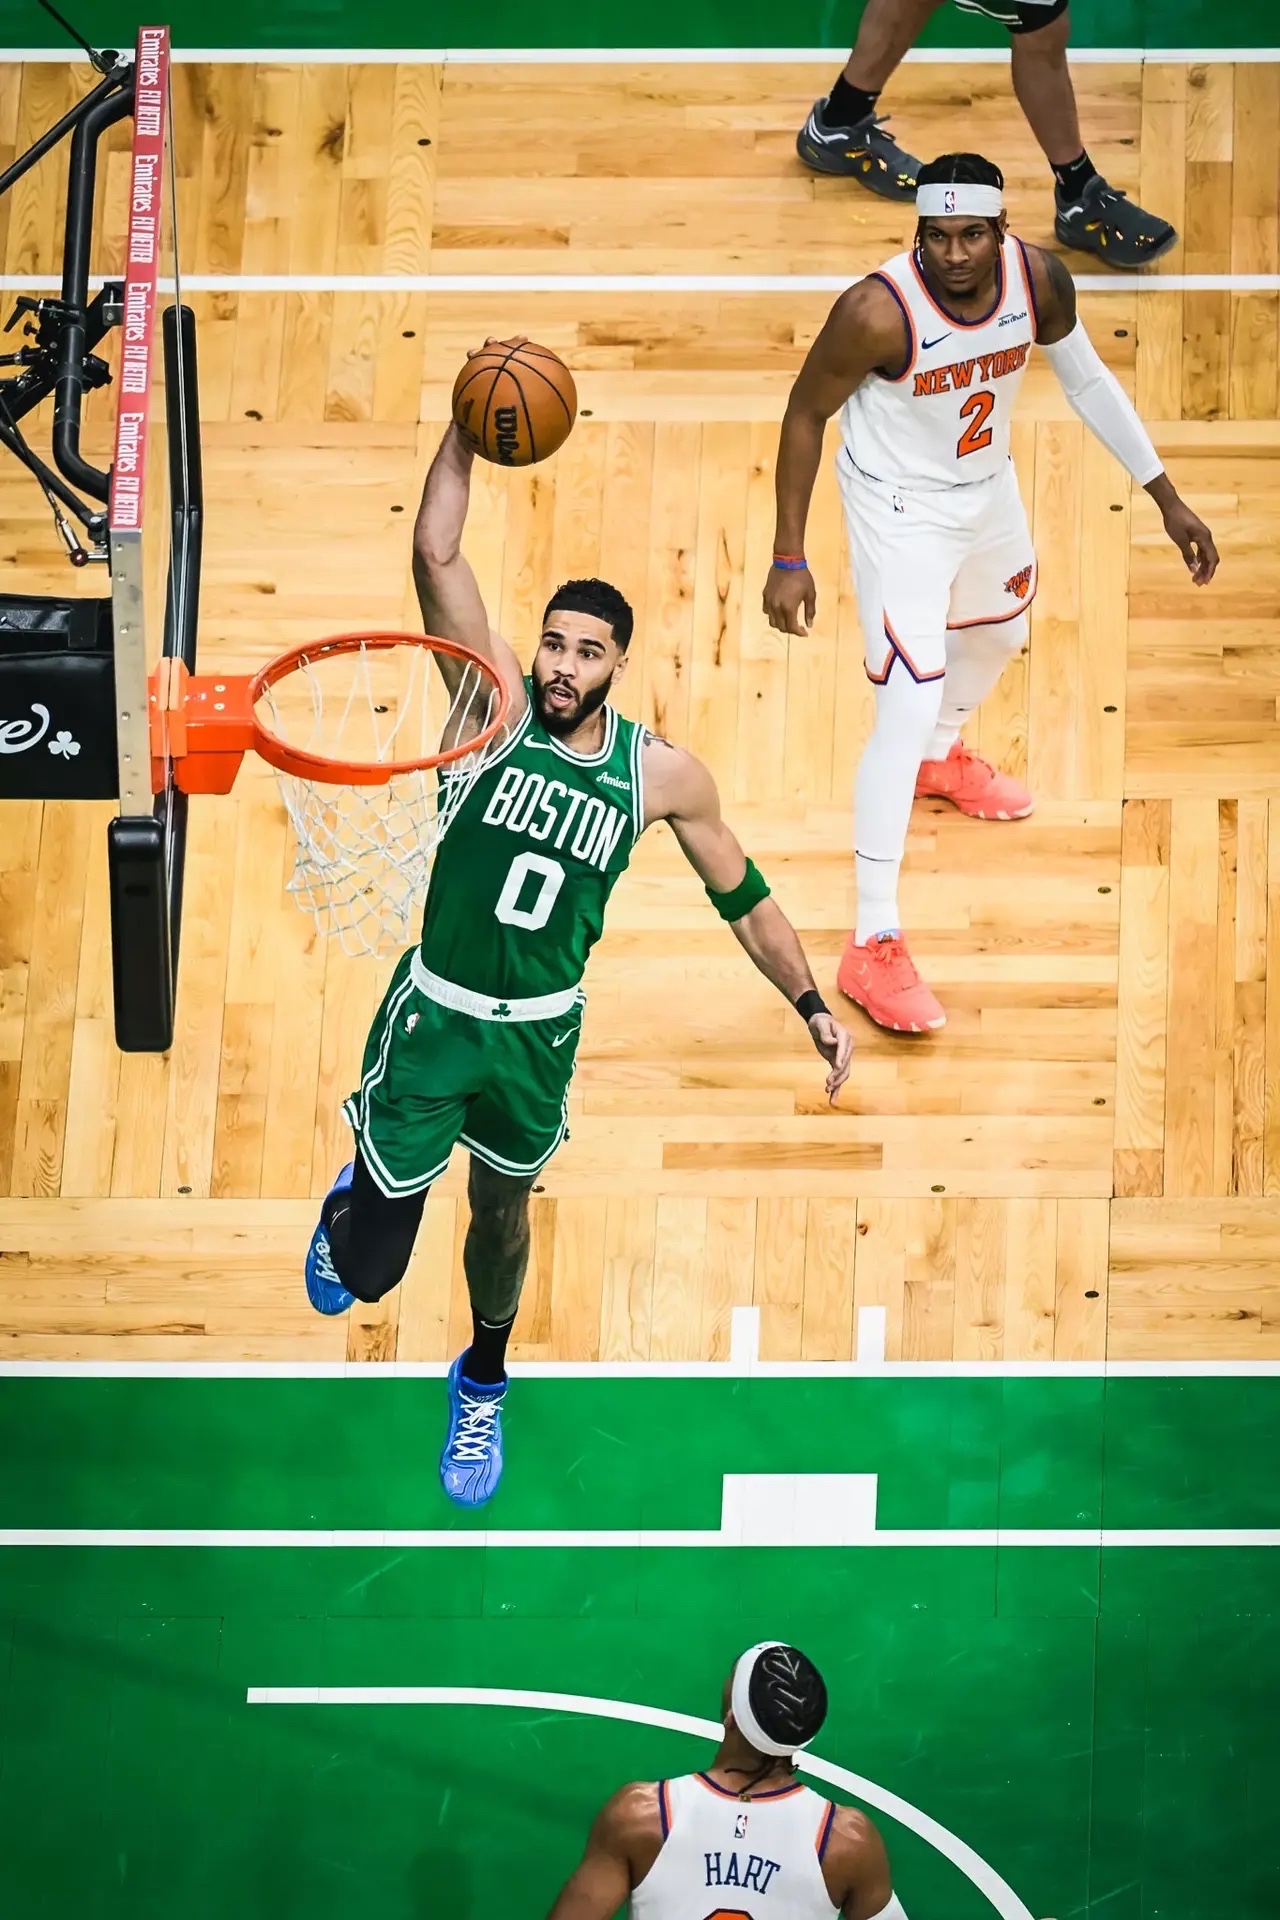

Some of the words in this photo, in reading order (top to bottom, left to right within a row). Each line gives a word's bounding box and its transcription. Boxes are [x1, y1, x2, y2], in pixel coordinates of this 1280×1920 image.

[139, 28, 165, 86] Emirates
[138, 89, 162, 107] FLY
[136, 105, 161, 136] BETTER
[132, 154, 159, 212] Emirates
[131, 216, 156, 232] FLY
[129, 232, 155, 263] BETTER
[125, 282, 153, 341] Emirates
[123, 345, 149, 361] FLY
[912, 358, 976, 397] NEW
[976, 341, 1031, 383] YORK
[122, 361, 148, 393] BETTER
[116, 412, 145, 473] Emirates
[956, 389, 996, 460] 2
[115, 476, 140, 493] FLY
[113, 492, 139, 526] BETTER
[0, 703, 50, 754] e
[595, 771, 631, 791] Amica
[481, 766, 629, 873] BOSTON
[494, 851, 566, 932] 0
[704, 1852, 781, 1895] HART
